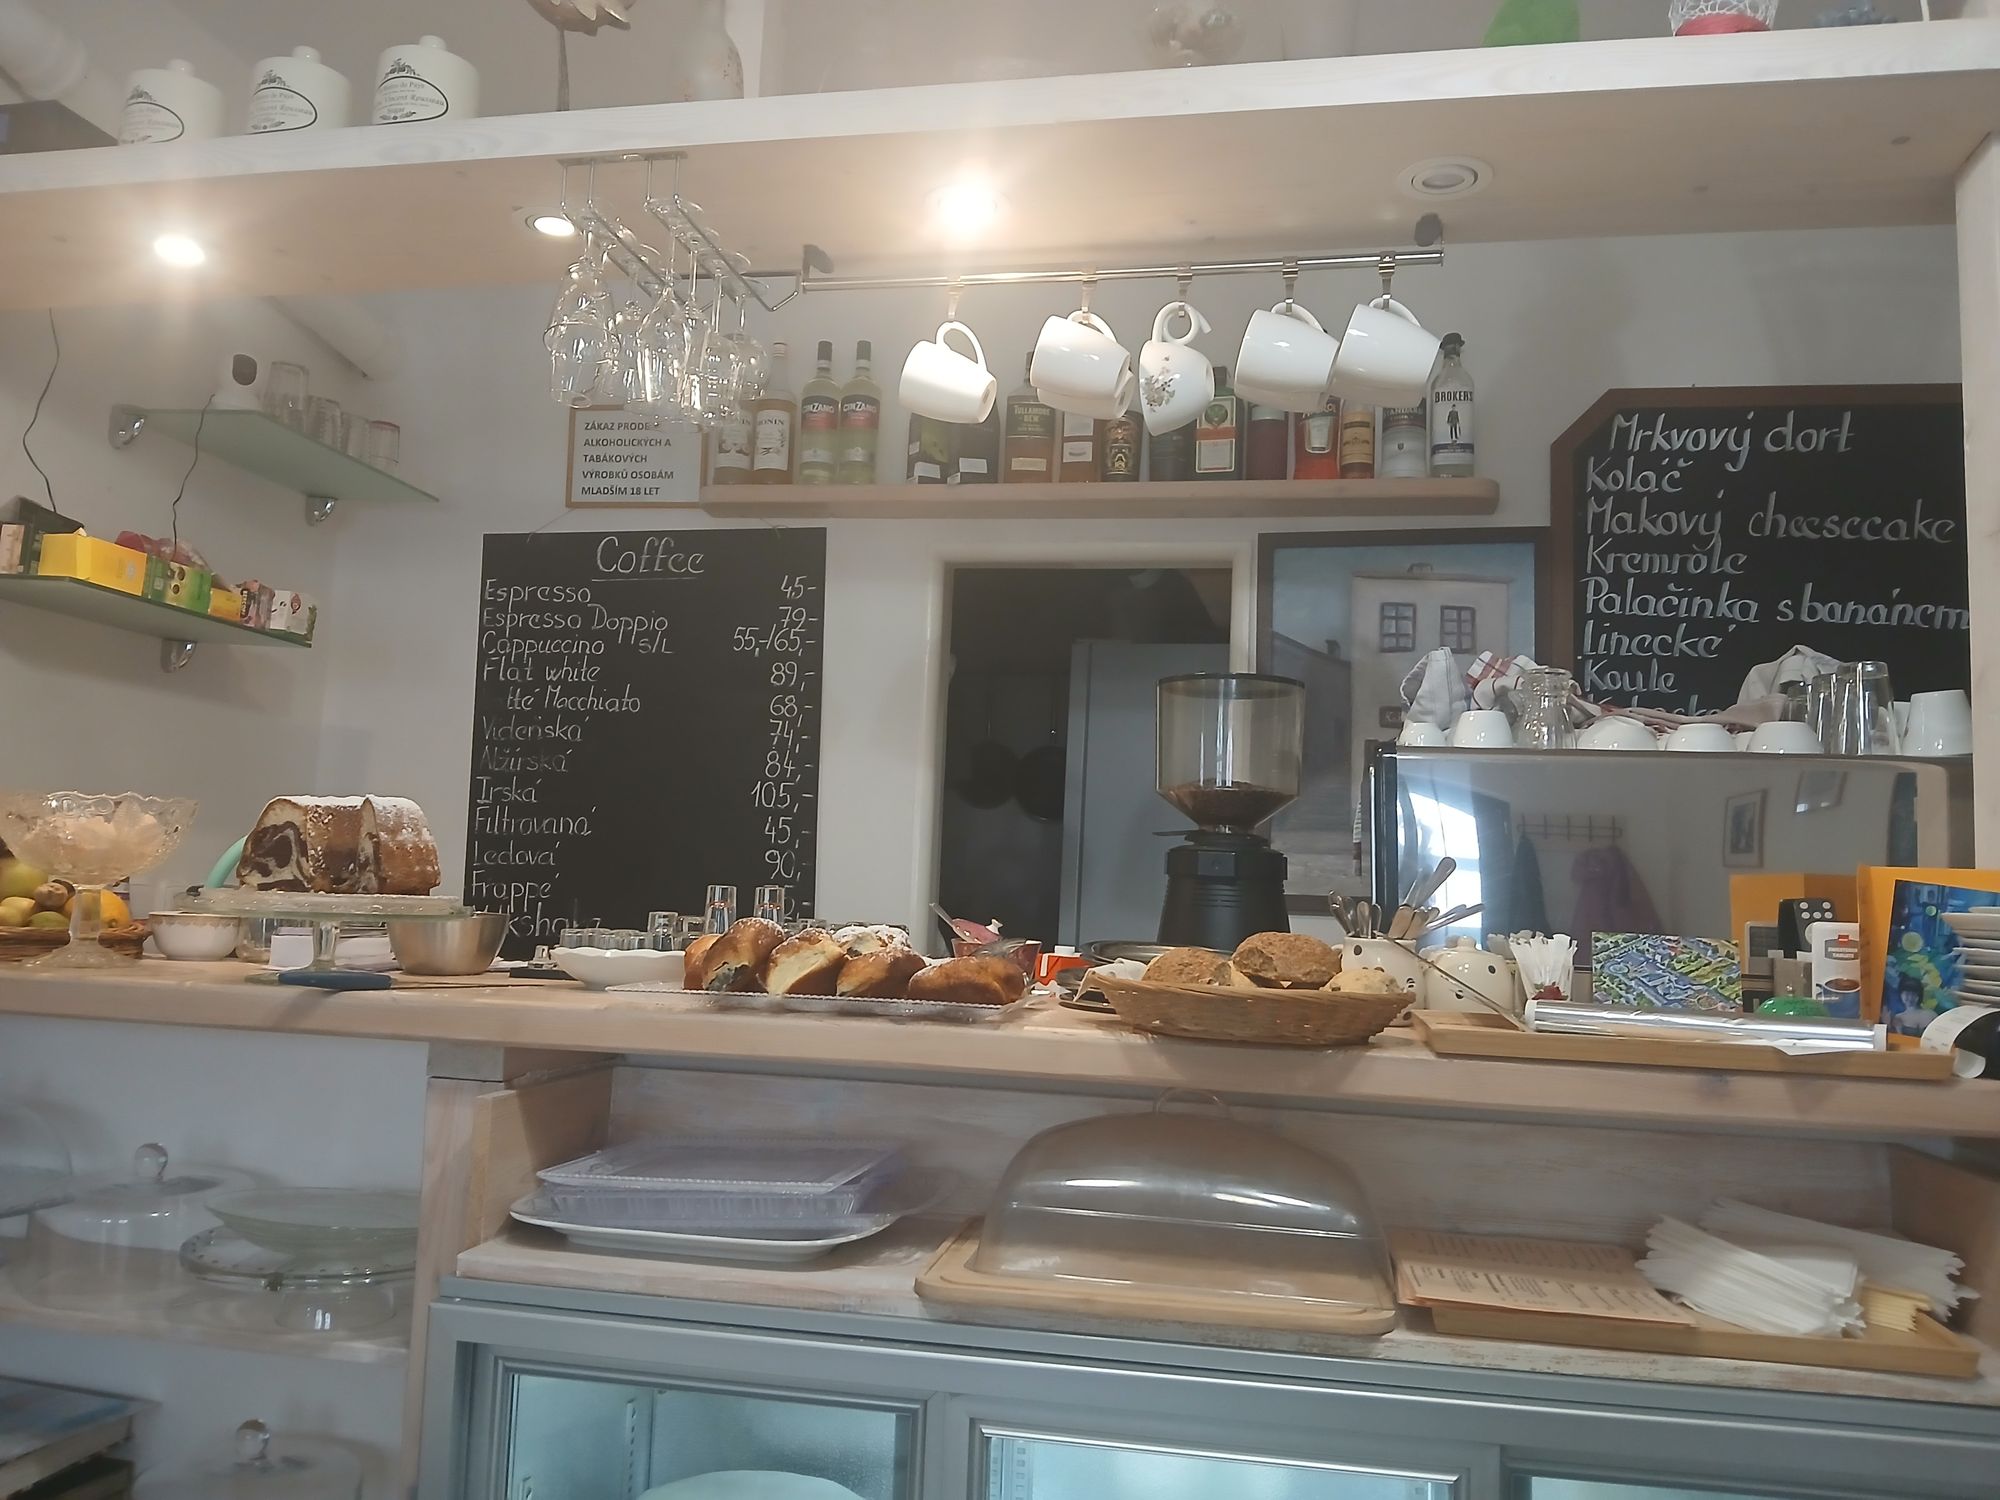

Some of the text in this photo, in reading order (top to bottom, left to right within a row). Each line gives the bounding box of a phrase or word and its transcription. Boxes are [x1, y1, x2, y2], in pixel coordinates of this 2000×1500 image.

[583, 437, 672, 447] ALKOHOLICKÝCH A
[584, 421, 653, 431] ZÁKAZ PRODE
[1609, 410, 1856, 472] Mrkvový dort
[582, 468, 674, 479] VÝROBKŮ OSOBÁM
[583, 452, 648, 463] TABÁKOVÝCH
[1586, 455, 1694, 493] Koláč
[581, 484, 660, 496] MLADŠÍM 18 LET
[1586, 489, 1957, 551] Makový cheesecake
[596, 536, 705, 574] Coffee
[485, 578, 591, 613] Espresso
[1580, 576, 1759, 623] Palačinka
[483, 603, 669, 644] Espresso Doppio
[1583, 619, 1735, 659] Linecké
[482, 630, 605, 663] Cappuccino
[483, 655, 601, 682] Flat white
[770, 661, 815, 692] 89,-
[1584, 660, 1678, 694] Koule
[544, 683, 641, 713] Macchiato
[770, 694, 813, 727] 68,-
[769, 718, 811, 754] 74,-
[765, 750, 814, 783] 84,-
[476, 776, 542, 804] Irská
[751, 780, 814, 813] 105,-
[474, 805, 596, 836] Filtrovaná
[765, 815, 812, 849] 45,-
[473, 840, 560, 866] Ledová
[764, 849, 808, 882] 90,-
[472, 869, 560, 912] Frappé
